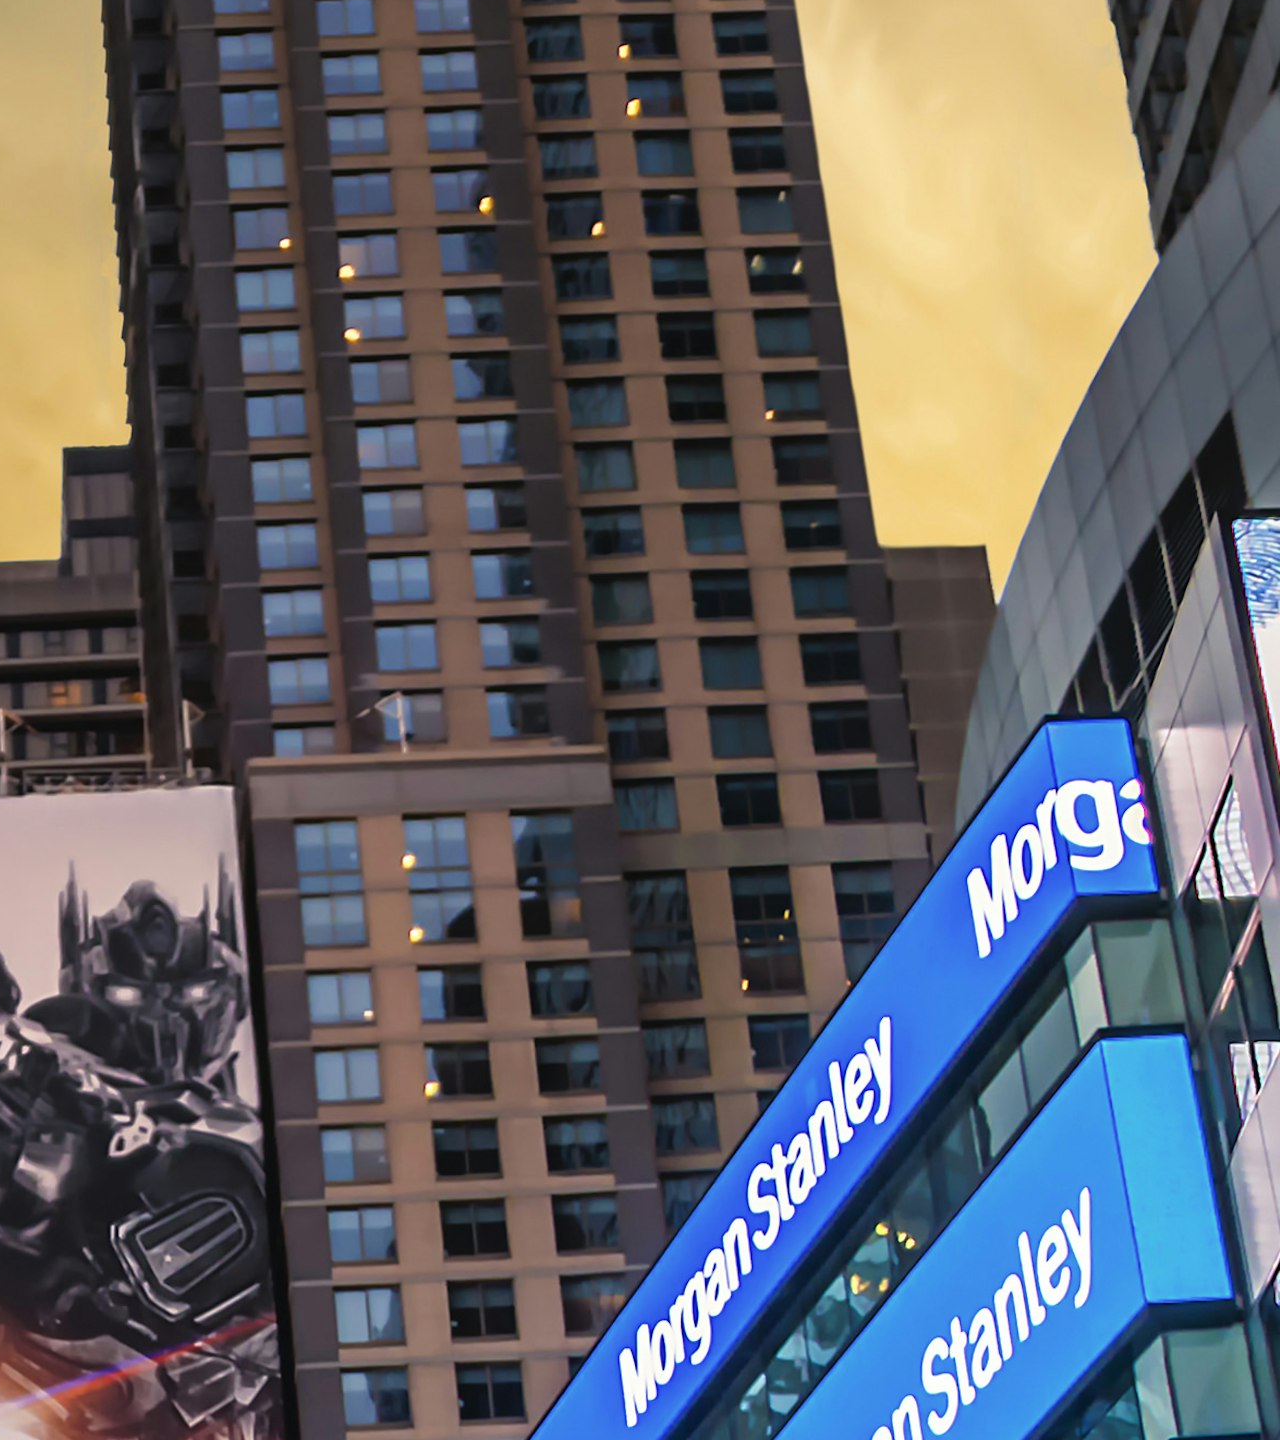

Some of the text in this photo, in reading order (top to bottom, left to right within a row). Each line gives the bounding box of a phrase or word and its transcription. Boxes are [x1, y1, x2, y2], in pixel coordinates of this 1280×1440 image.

[620, 1017, 890, 1427] Morgan Stanley
[922, 1187, 1091, 1434] Stanley
